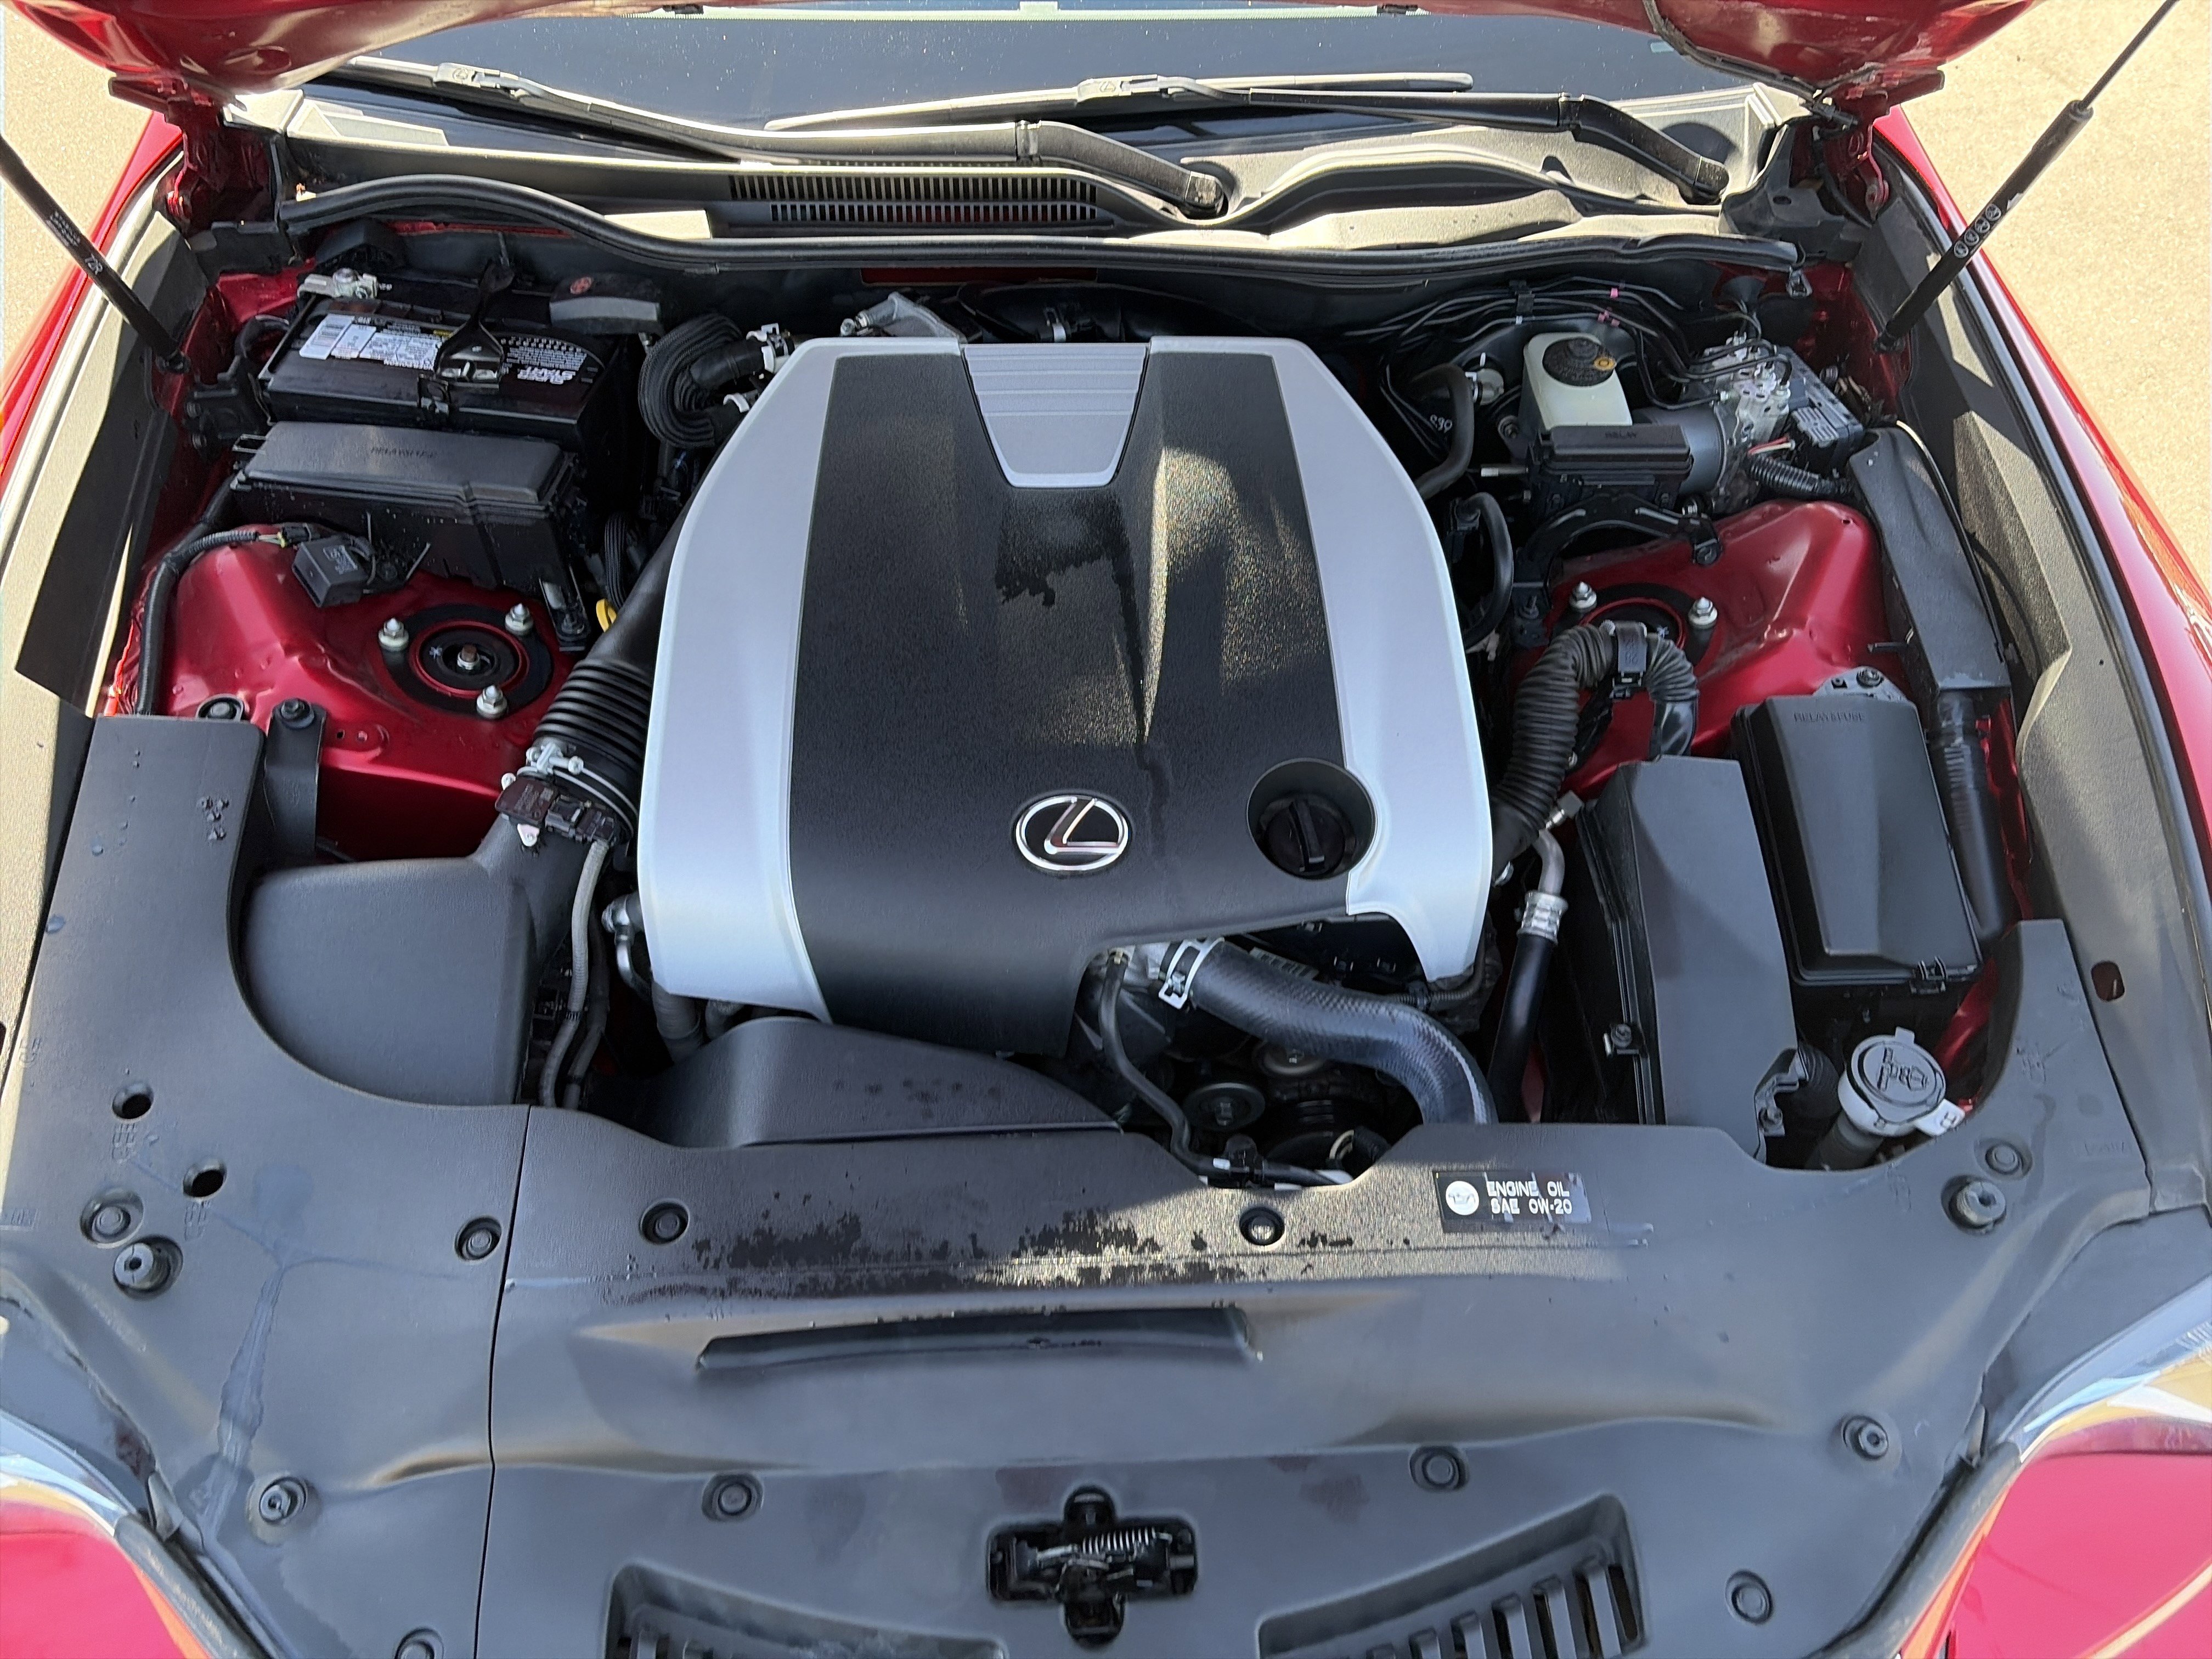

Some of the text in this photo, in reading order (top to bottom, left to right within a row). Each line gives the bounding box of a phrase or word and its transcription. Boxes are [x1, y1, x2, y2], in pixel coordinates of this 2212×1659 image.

[1486, 1181, 1570, 1197] ENGINE OIL
[1491, 1198, 1572, 1215] SAE 0W-20
